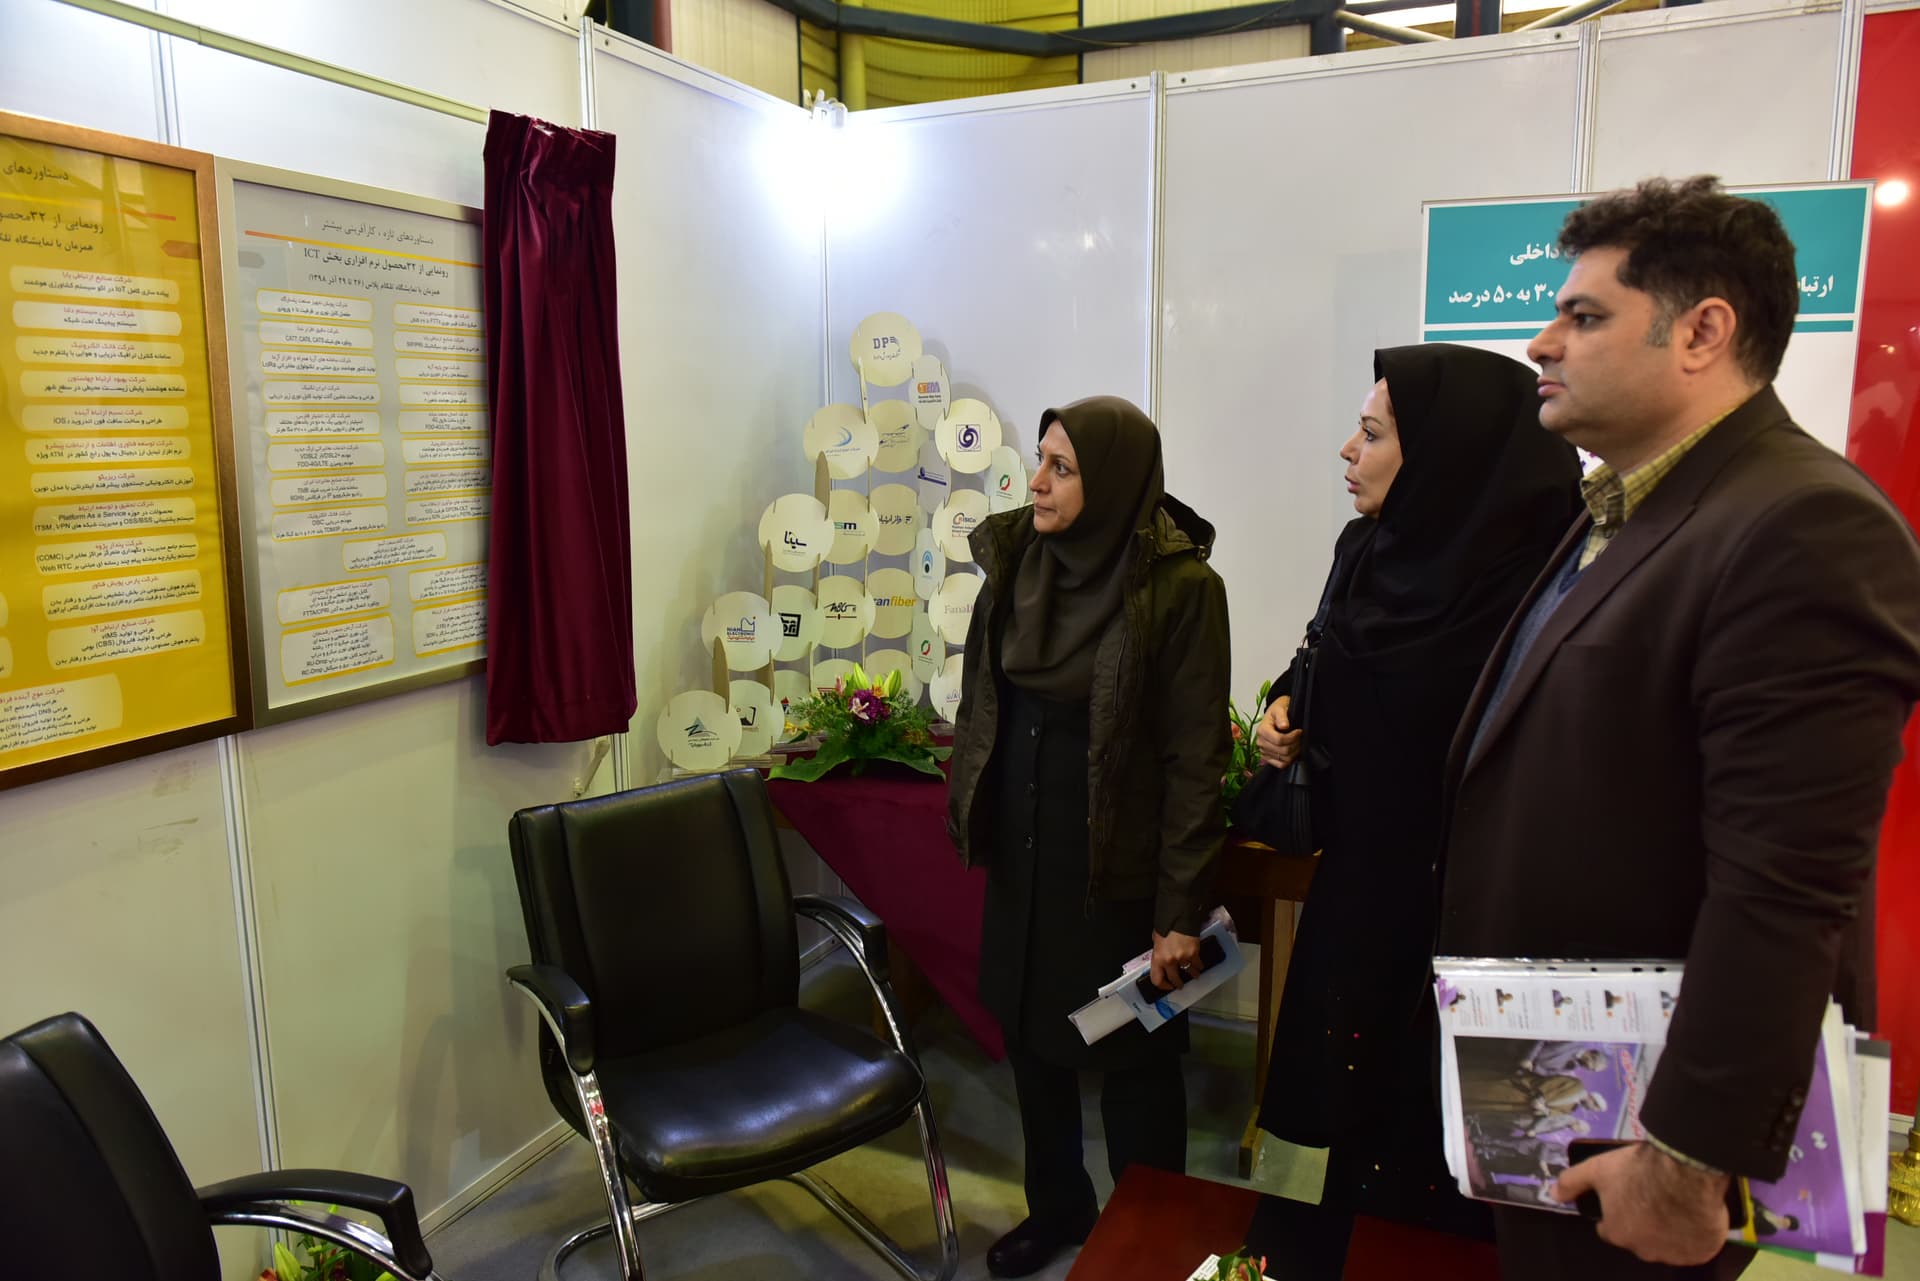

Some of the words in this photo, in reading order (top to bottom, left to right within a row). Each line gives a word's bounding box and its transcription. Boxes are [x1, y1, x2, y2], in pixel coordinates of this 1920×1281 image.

[2, 161, 69, 181] دستاوردهای
[0, 210, 46, 223] ۳۲محصو
[53, 213, 61, 229] از
[65, 216, 104, 234] رونمایی
[15, 234, 54, 248] نمایشگاه
[56, 239, 62, 249] با
[64, 240, 93, 253] همزمان
[304, 247, 320, 259] ICT
[322, 252, 342, 263] بخش
[1510, 243, 1560, 265] داخلی
[344, 255, 367, 267] افزاری
[370, 259, 379, 271] نرم
[418, 263, 424, 275] از
[425, 264, 449, 278] رونمایی
[1534, 283, 1555, 302] ۳۰
[1796, 274, 1834, 298] ارتبا
[1448, 289, 1490, 307] درصد
[1493, 285, 1513, 303] ۵۰
[1516, 288, 1531, 305] به
